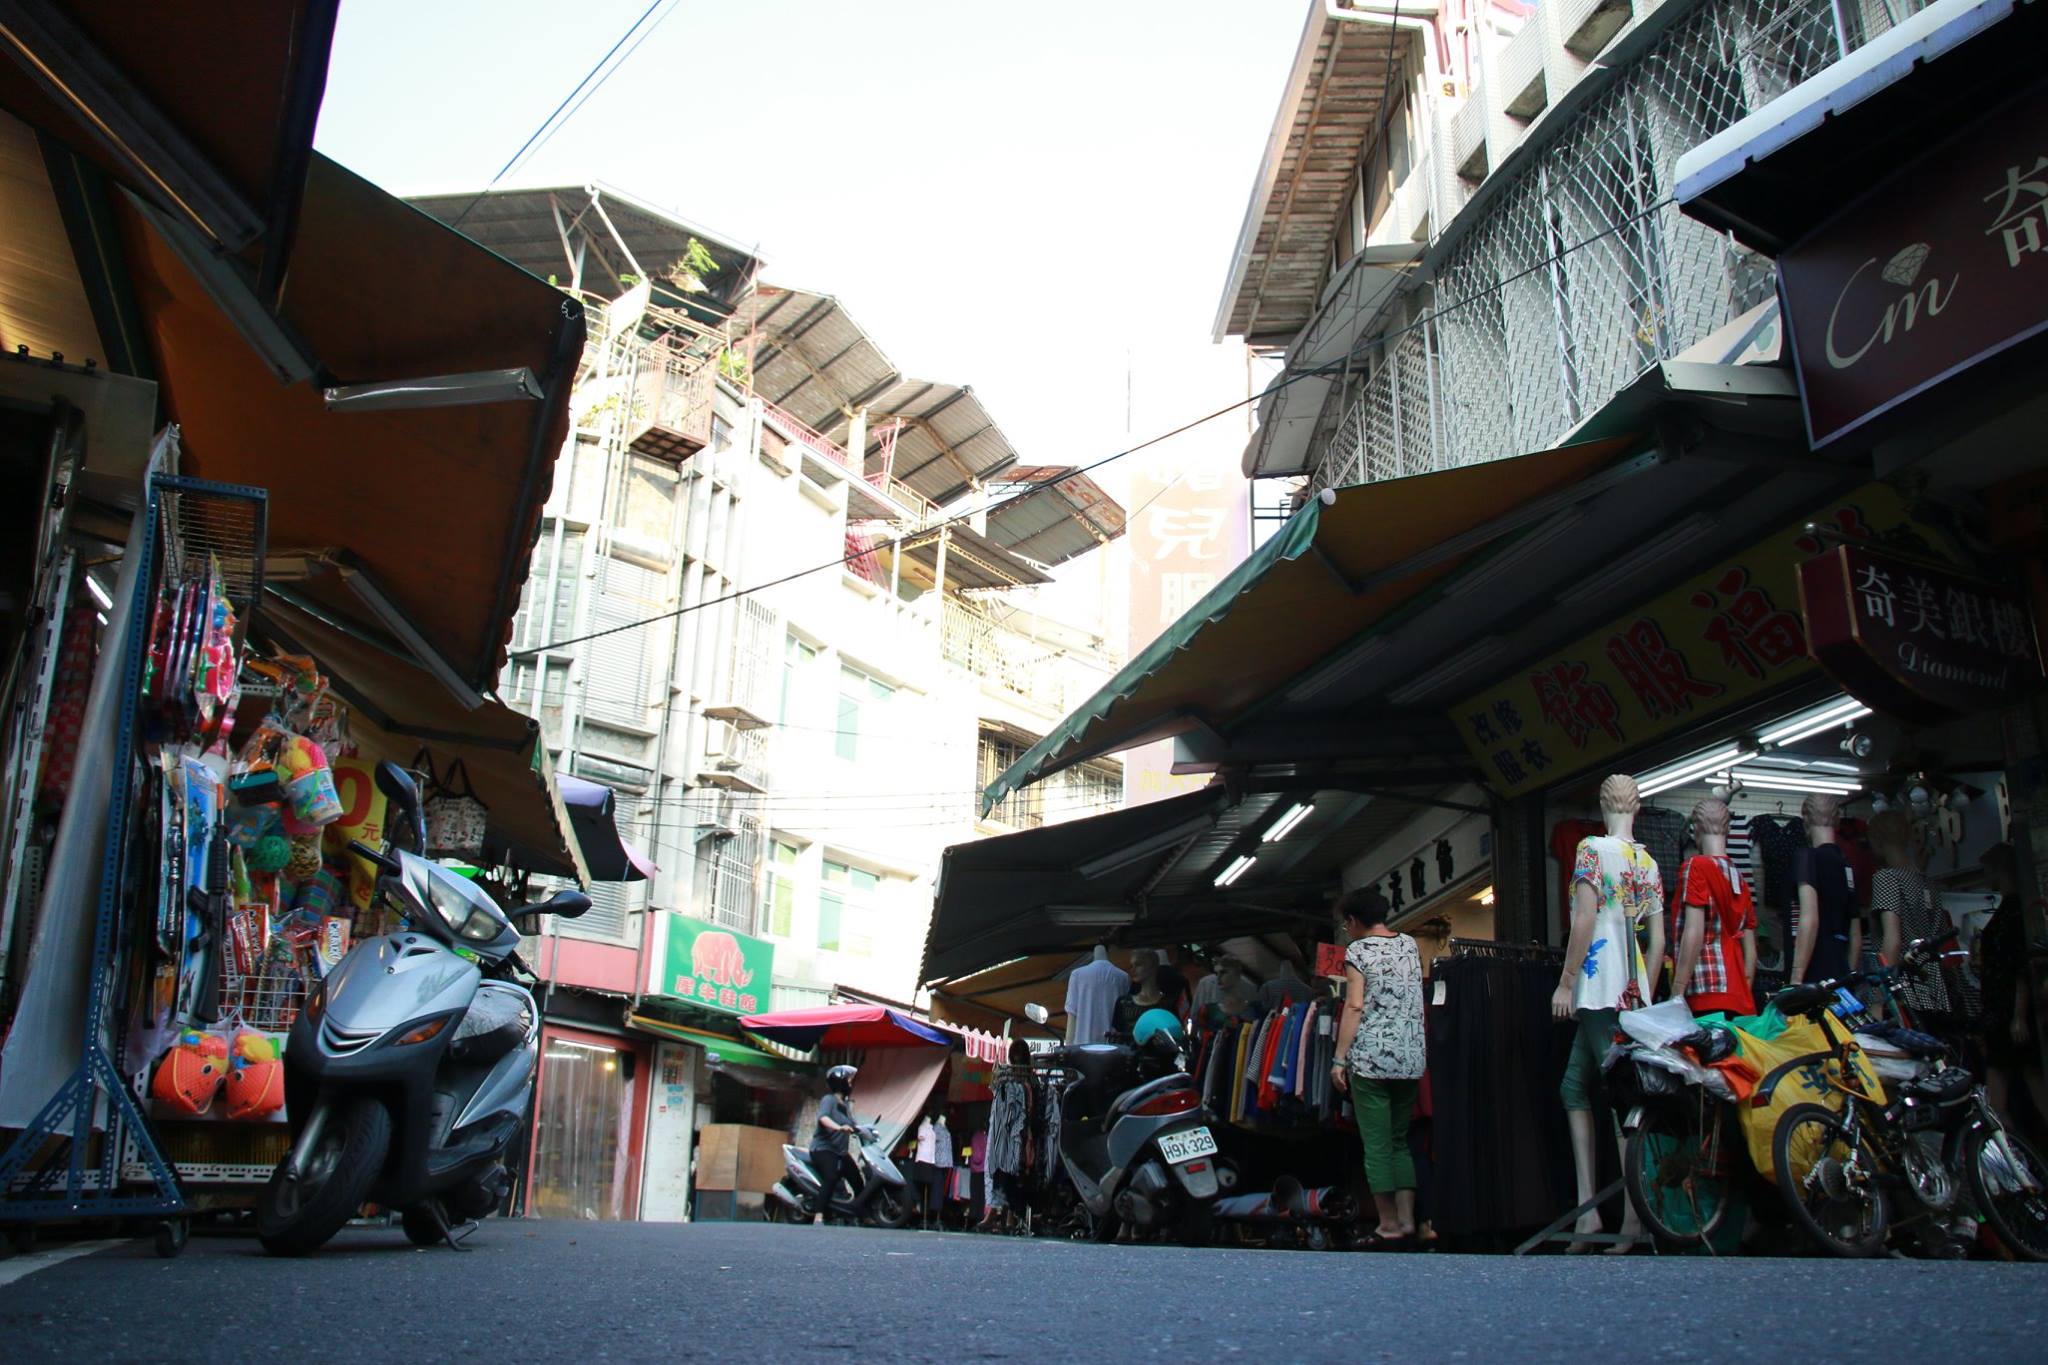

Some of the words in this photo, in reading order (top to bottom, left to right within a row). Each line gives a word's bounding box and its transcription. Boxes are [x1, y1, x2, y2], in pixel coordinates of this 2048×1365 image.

[1856, 564, 2032, 660] 奇美銀樓
[1897, 640, 2008, 692] Diamond
